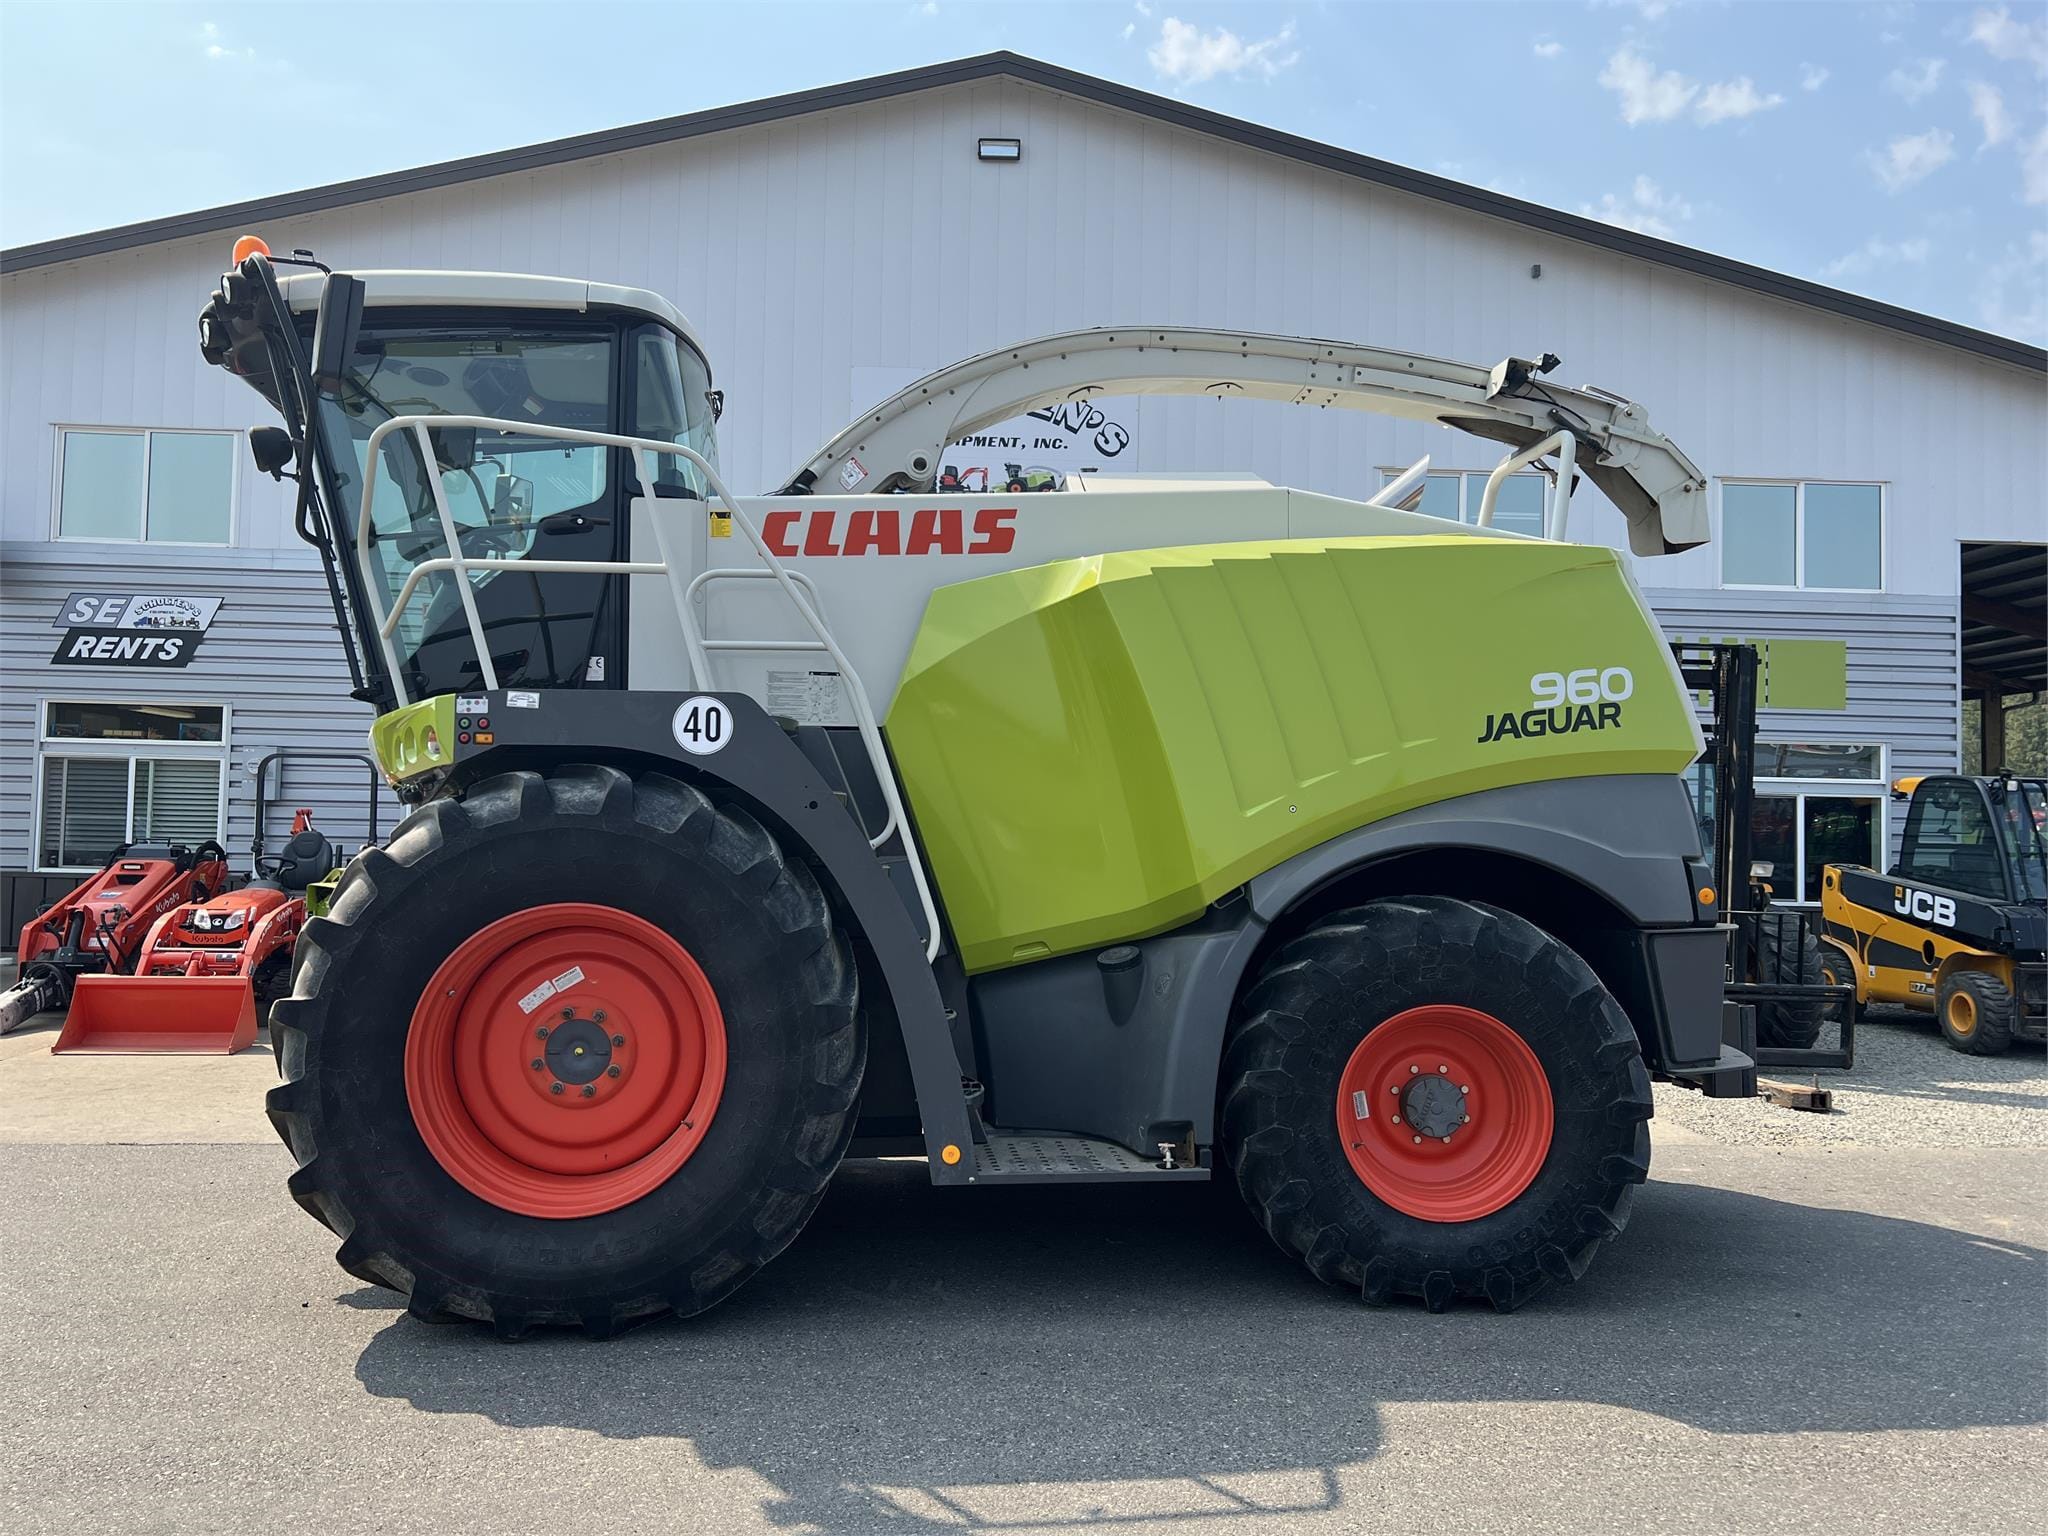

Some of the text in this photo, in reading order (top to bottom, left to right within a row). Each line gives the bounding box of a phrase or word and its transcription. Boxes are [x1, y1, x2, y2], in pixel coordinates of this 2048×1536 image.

[1033, 438, 1069, 449] INC.
[761, 509, 1018, 557] CLAAS
[68, 597, 127, 623] SE
[134, 597, 202, 617] SCHULTEN'S
[68, 636, 183, 660] RENTS
[1530, 666, 1634, 709] 960
[683, 706, 721, 742] 40
[1477, 702, 1622, 743] JAGUAR
[155, 892, 180, 912] Kubota
[276, 907, 293, 922] Kubota
[1894, 888, 1956, 927] JCB
[192, 934, 224, 943] Kubota
